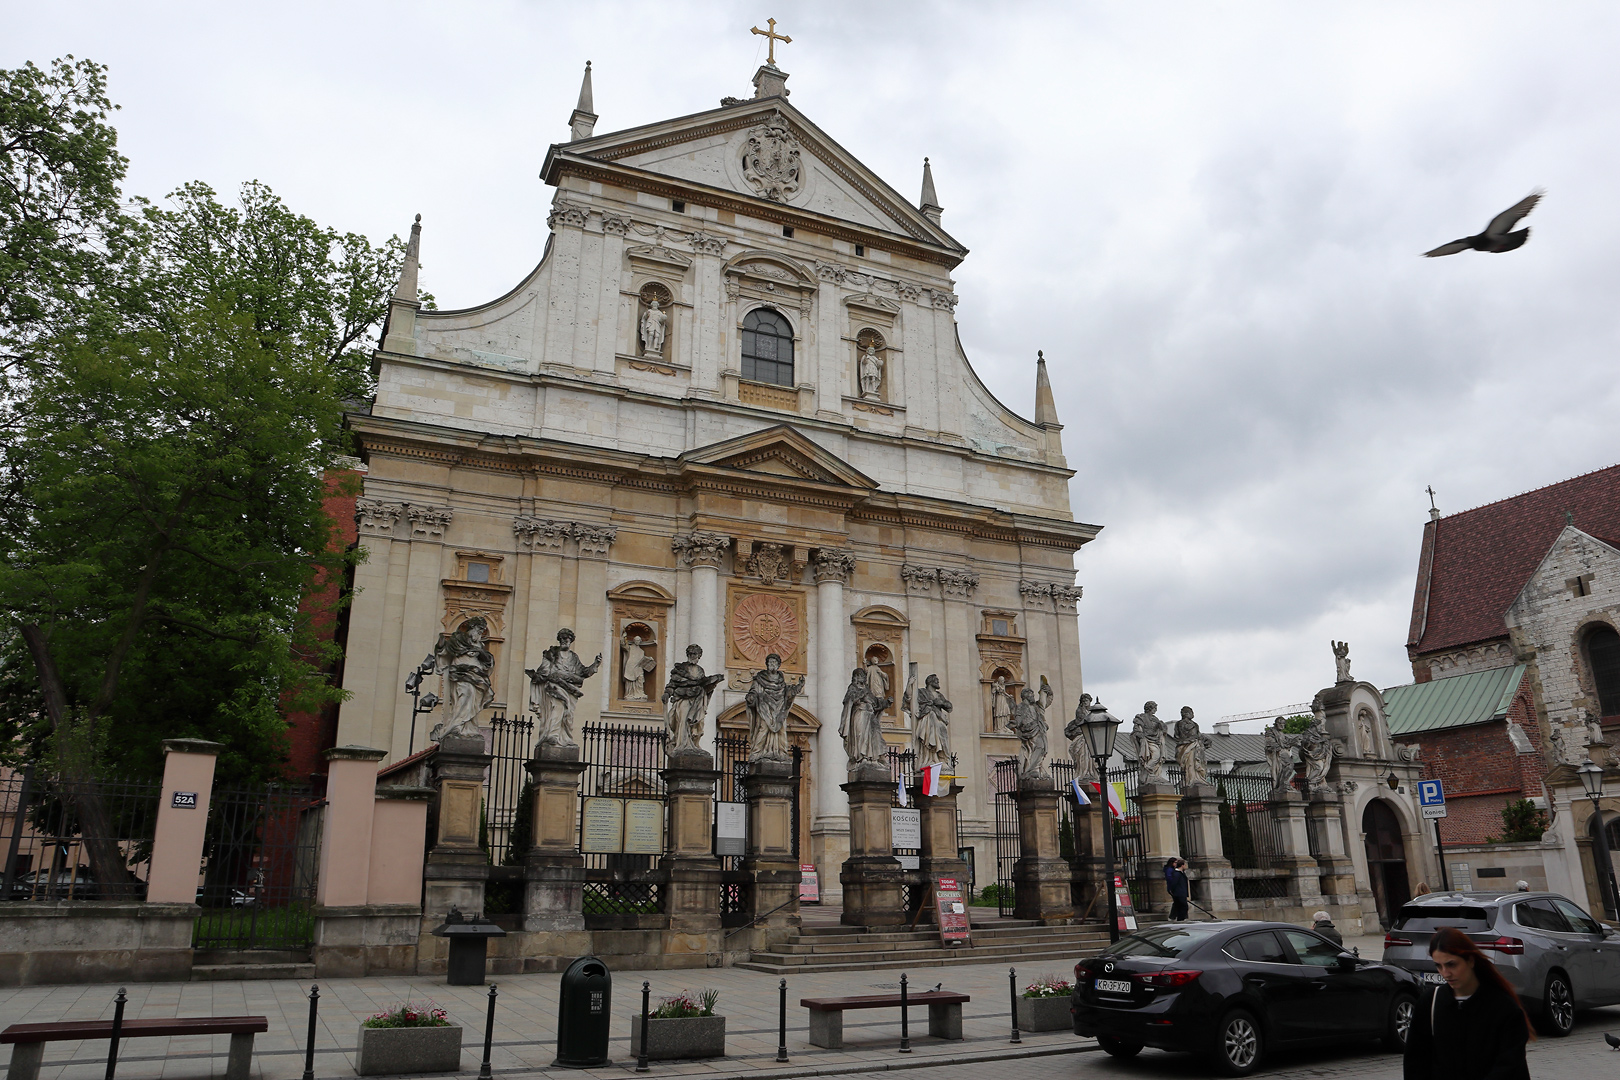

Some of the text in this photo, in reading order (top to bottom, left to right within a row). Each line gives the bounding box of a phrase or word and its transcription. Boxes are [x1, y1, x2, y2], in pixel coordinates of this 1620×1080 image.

[1422, 783, 1438, 803] P
[175, 795, 195, 804] 52A
[1424, 808, 1445, 816] Koniec
[893, 815, 919, 823] KOŚCIÓŁ
[1098, 980, 1108, 990] KR
